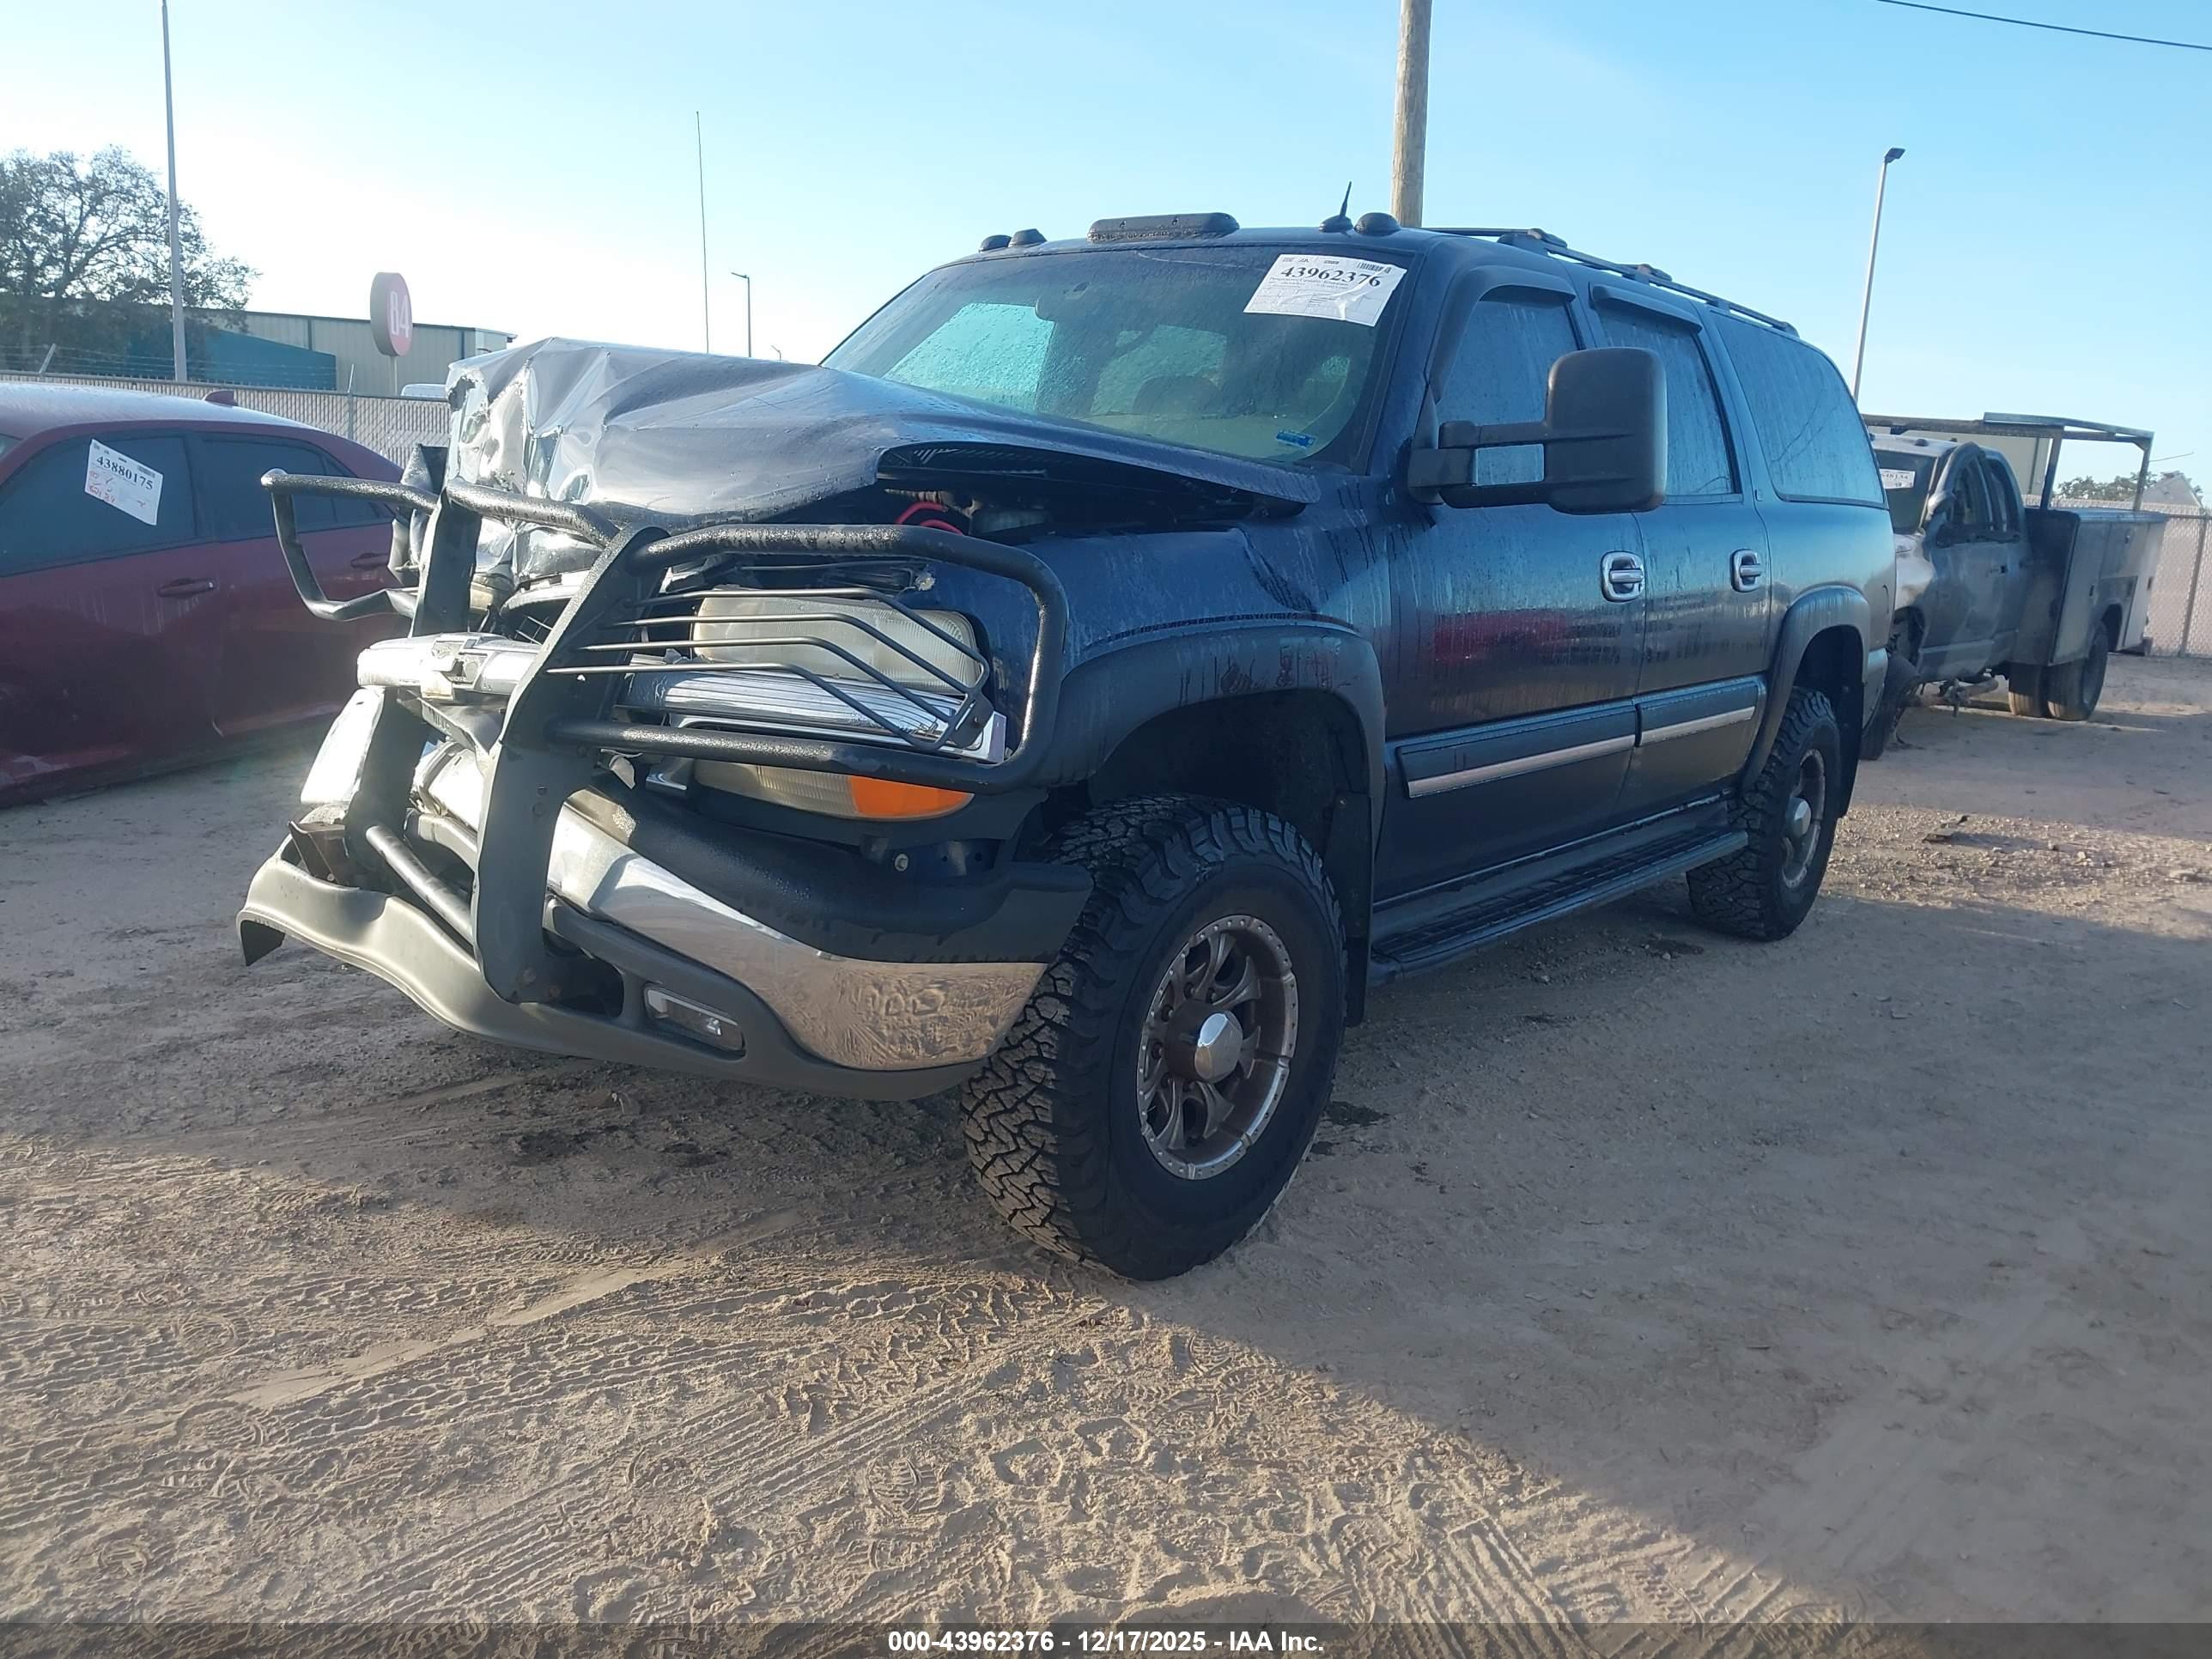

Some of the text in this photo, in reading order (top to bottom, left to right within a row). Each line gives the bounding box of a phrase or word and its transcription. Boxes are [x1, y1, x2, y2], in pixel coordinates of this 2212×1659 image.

[1280, 266, 1385, 287] 43962376
[390, 290, 410, 338] 84
[96, 456, 154, 490] 43880175
